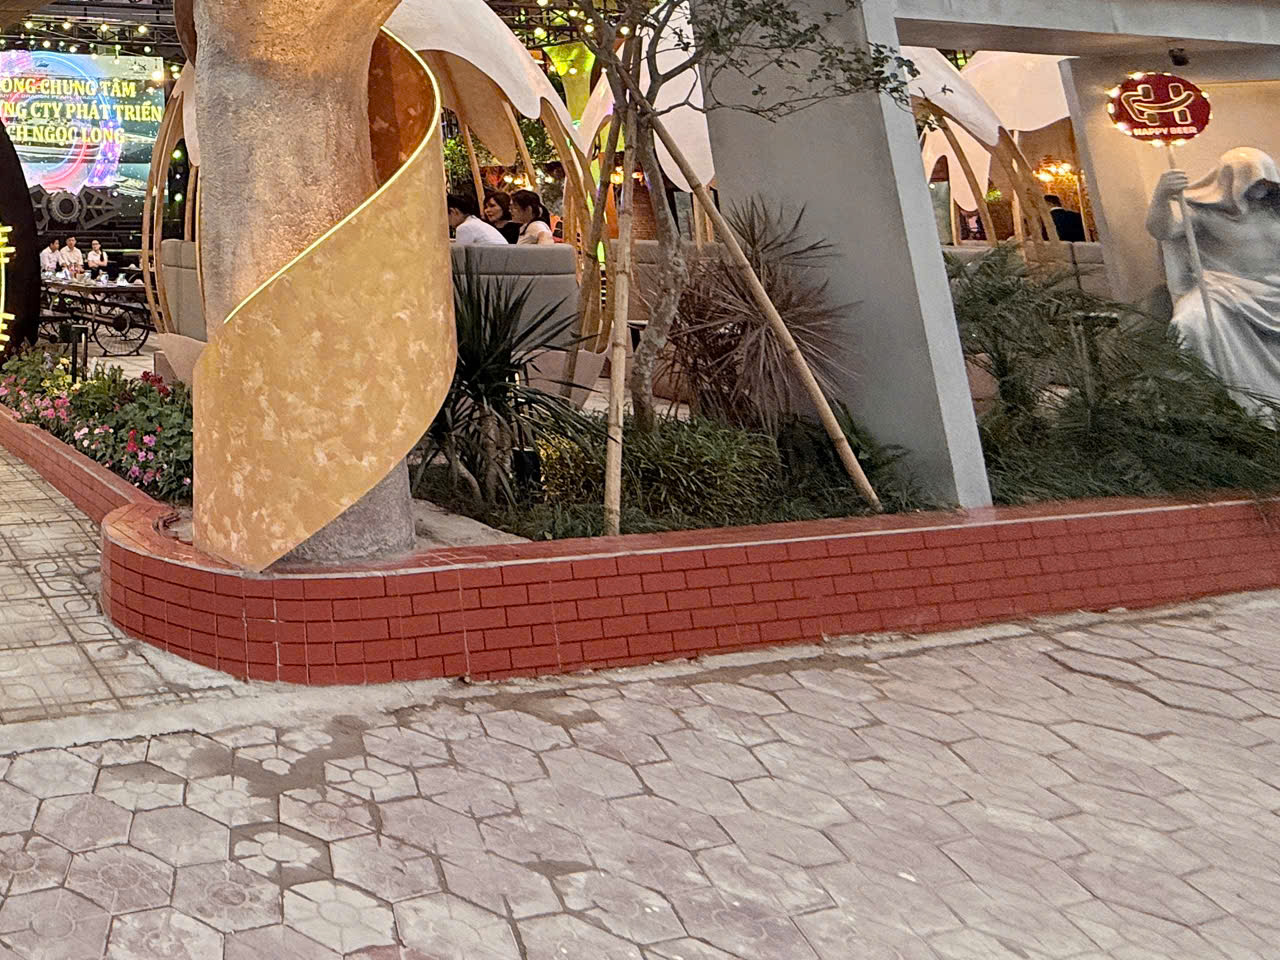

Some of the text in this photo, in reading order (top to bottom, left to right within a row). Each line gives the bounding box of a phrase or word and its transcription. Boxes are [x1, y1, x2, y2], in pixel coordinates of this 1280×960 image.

[40, 78, 97, 96] CHUNG
[99, 77, 136, 98] TÂM
[30, 101, 64, 119] CTY
[66, 99, 111, 120] PHÁT
[81, 126, 125, 145] LONG
[1133, 126, 1197, 136] HAPPY BEER
